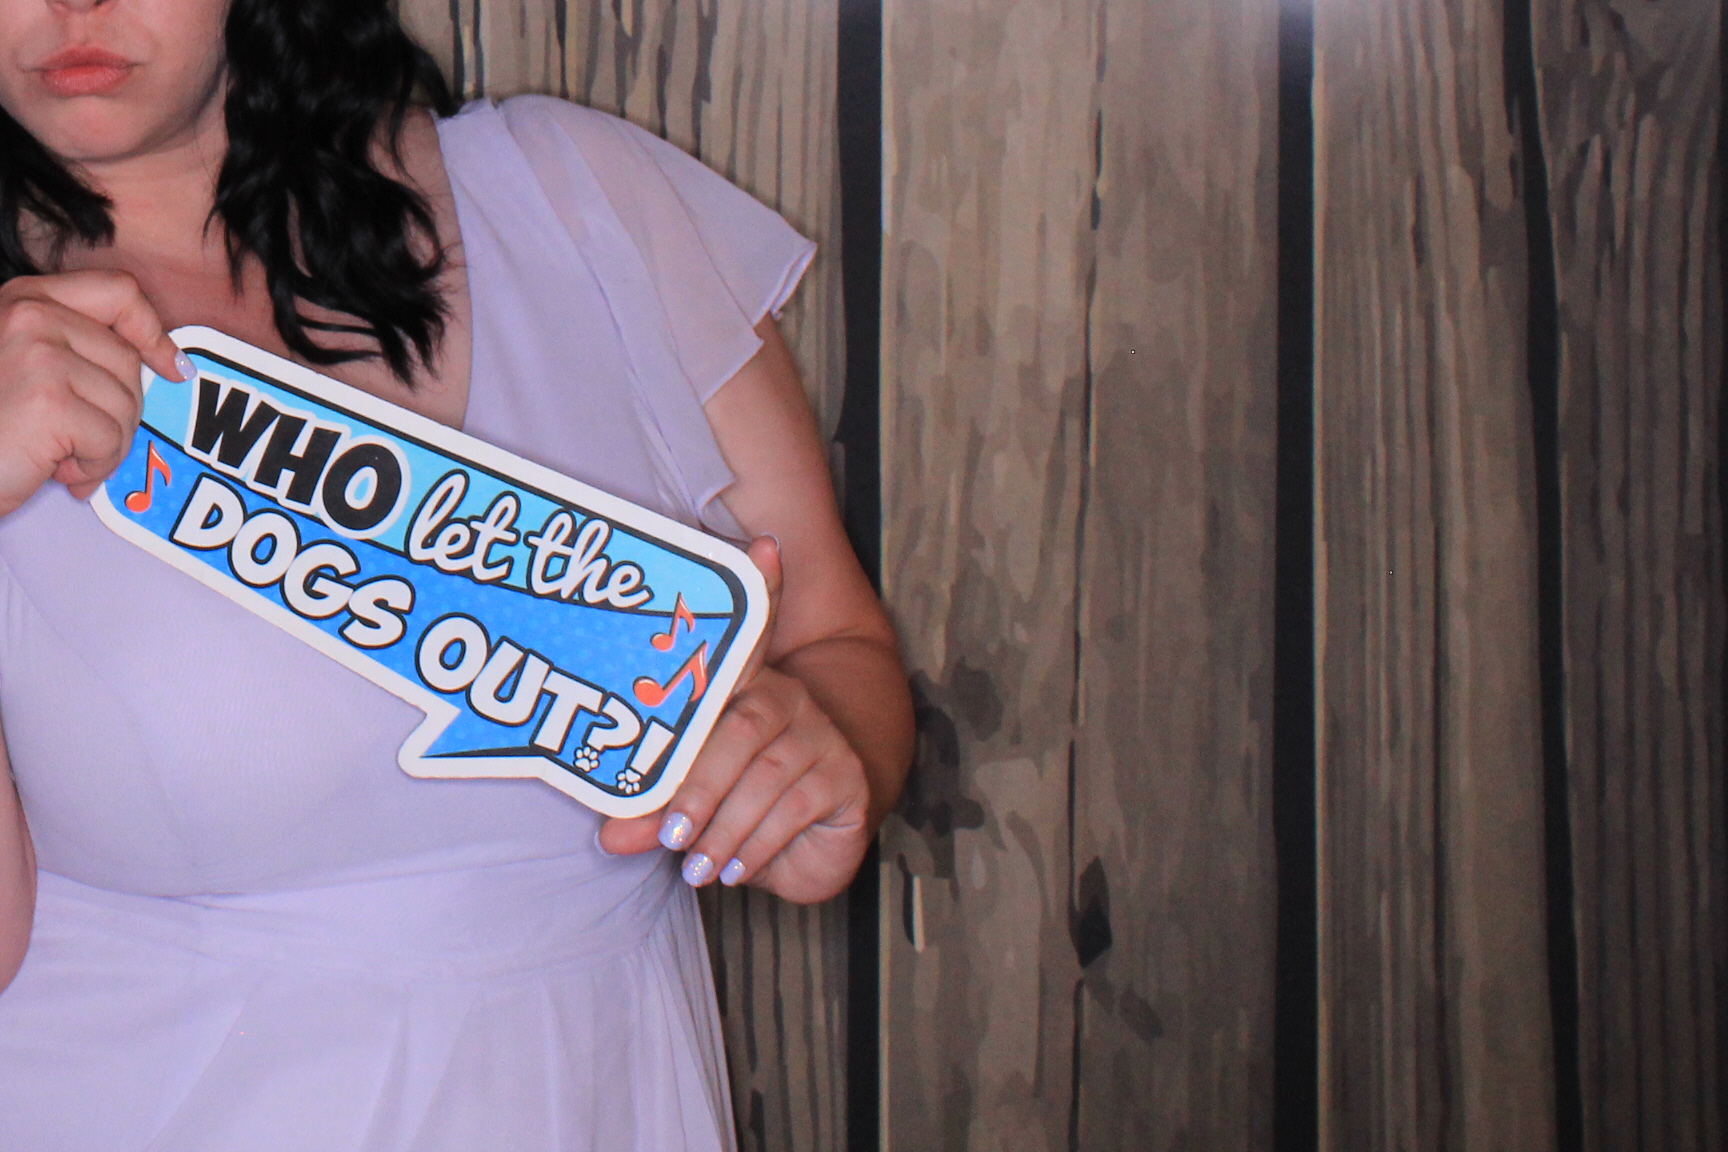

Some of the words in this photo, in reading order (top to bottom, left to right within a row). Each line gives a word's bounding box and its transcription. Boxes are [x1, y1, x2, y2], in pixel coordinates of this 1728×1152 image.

[190, 377, 403, 531] WHO
[406, 468, 523, 583] let
[525, 507, 652, 610] the
[171, 472, 415, 649] DOGS
[416, 613, 675, 794] OUT?!
